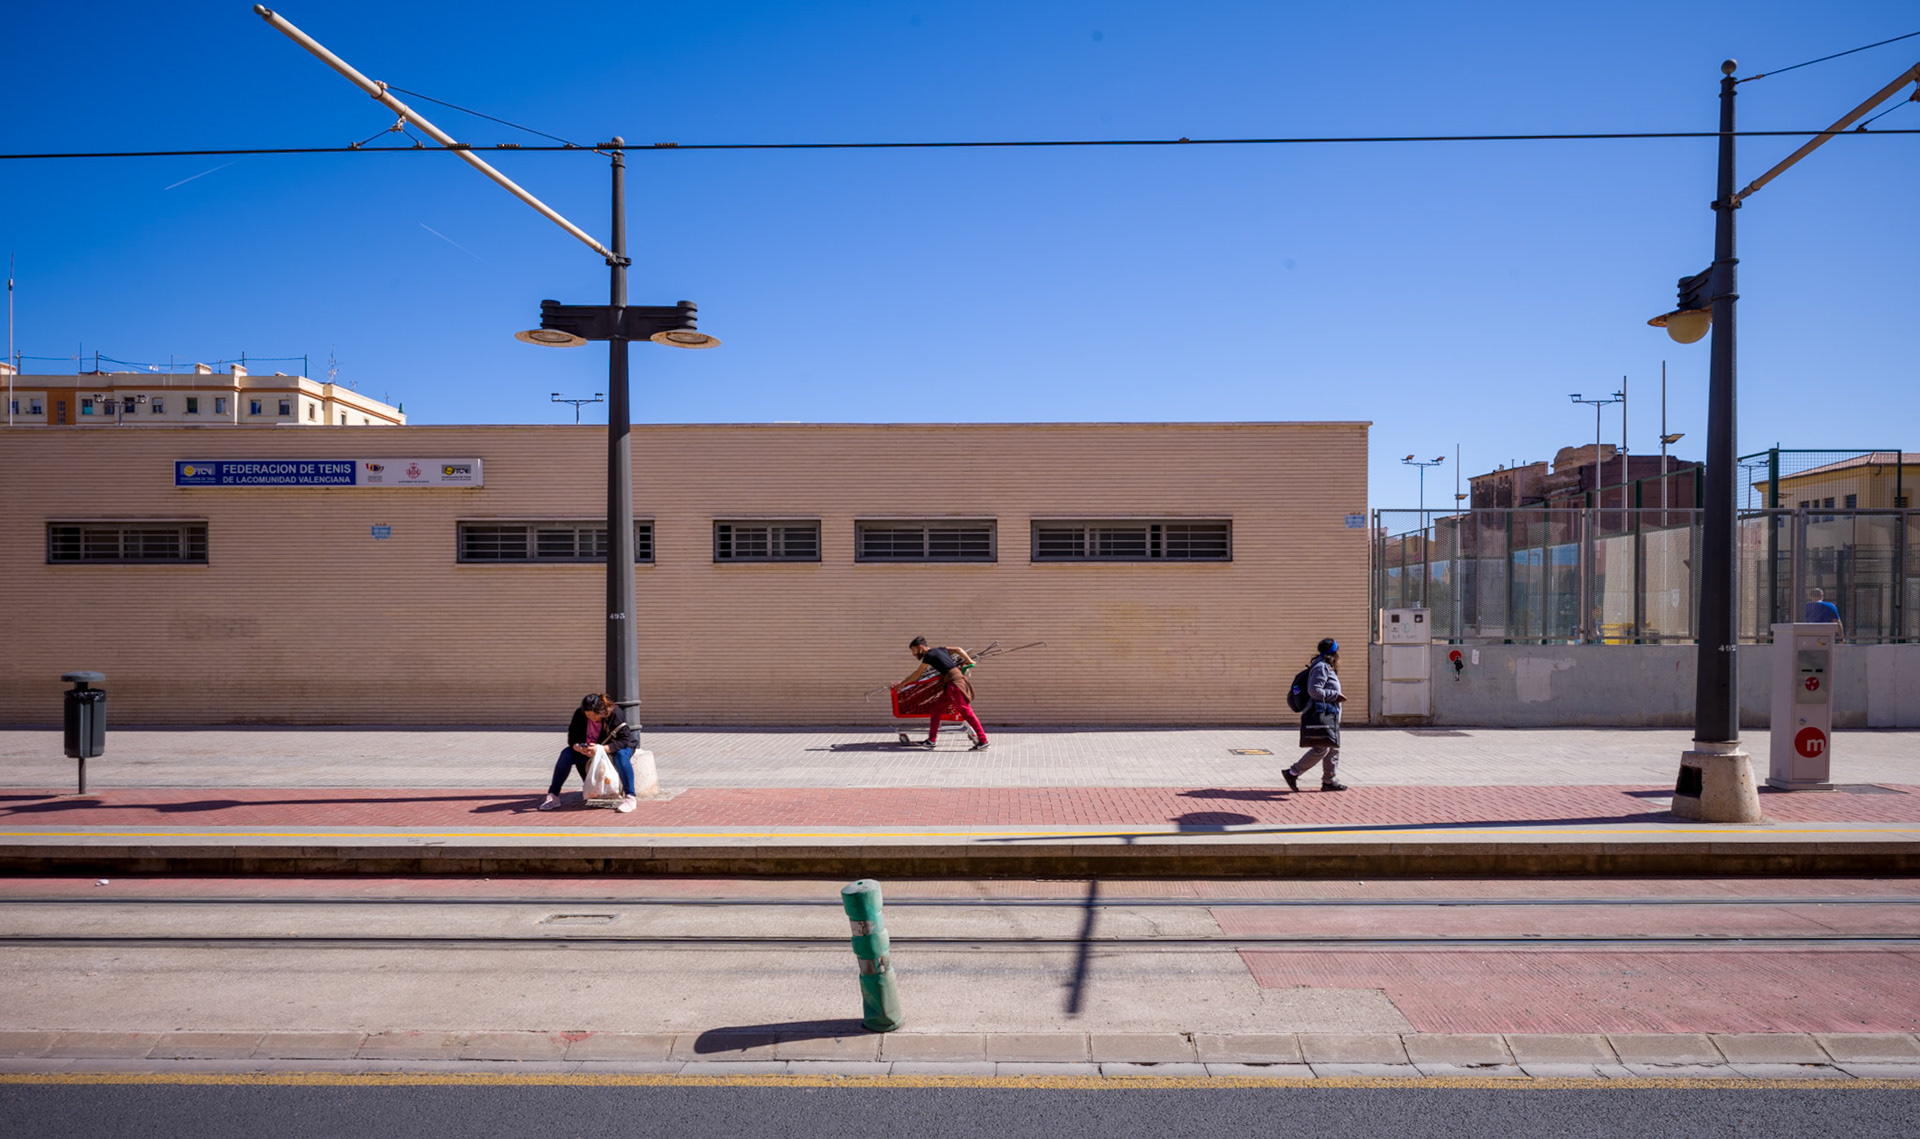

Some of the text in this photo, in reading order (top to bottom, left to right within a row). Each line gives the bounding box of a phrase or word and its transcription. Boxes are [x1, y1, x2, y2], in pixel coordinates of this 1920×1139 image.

[223, 464, 351, 474] FEDERACION DE TENIS
[1806, 738, 1825, 752] m
